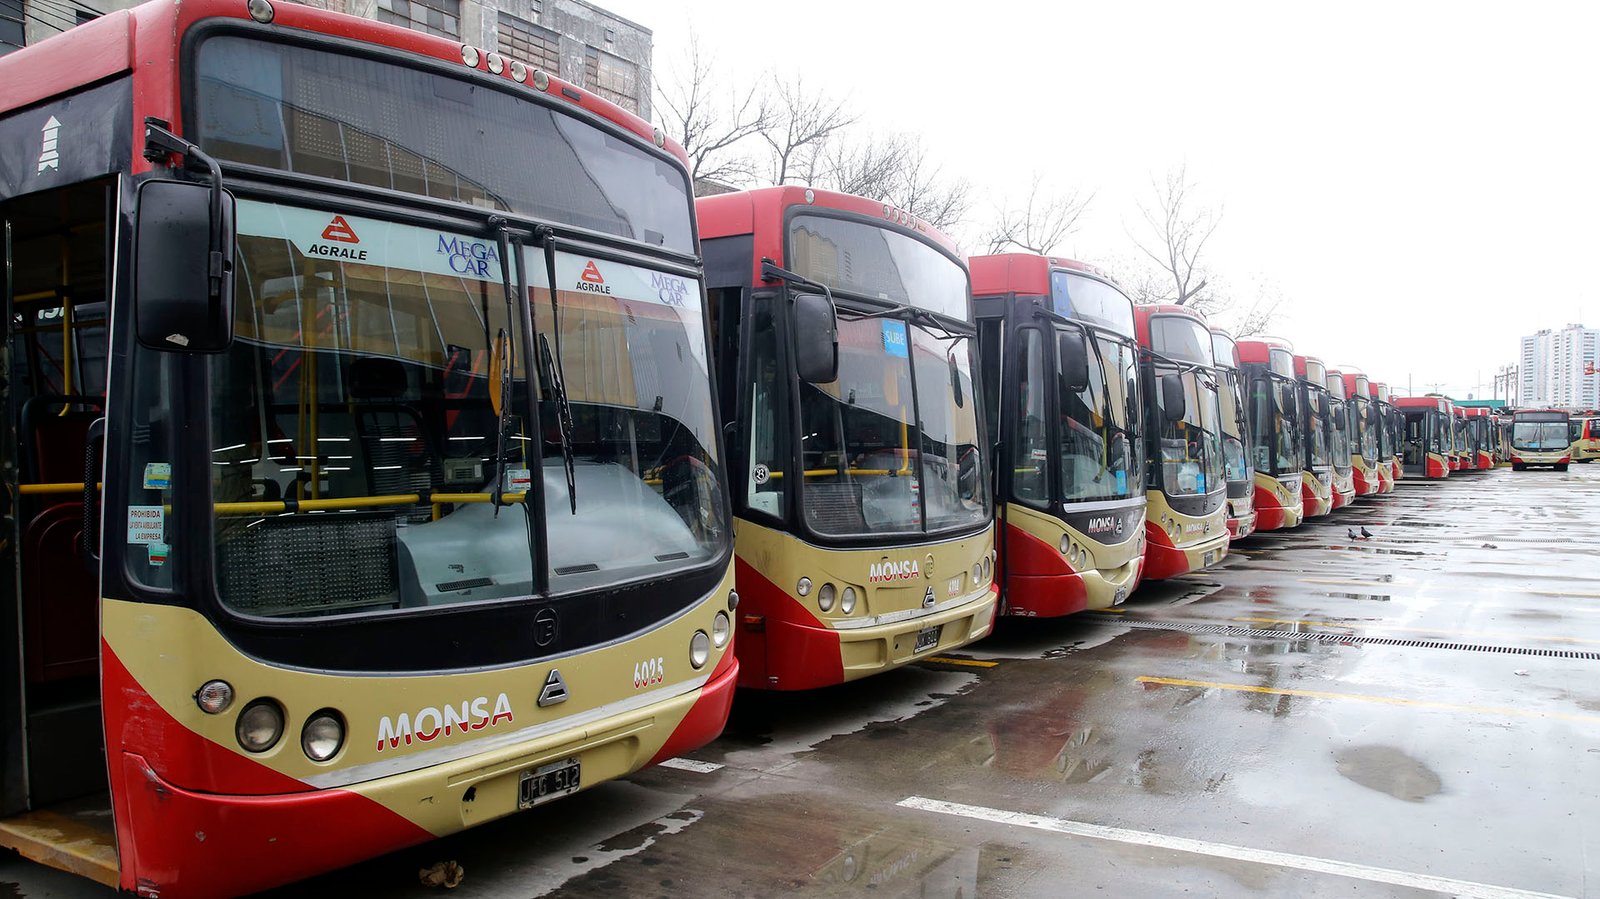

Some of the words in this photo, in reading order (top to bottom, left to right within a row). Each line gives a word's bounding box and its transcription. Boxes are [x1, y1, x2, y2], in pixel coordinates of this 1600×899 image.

[308, 244, 368, 261] AGRALE
[437, 234, 499, 263] MEGA
[449, 254, 492, 279] CAR
[575, 281, 611, 295] AGRALE
[651, 272, 689, 295] MEGA
[658, 289, 685, 307] CAR
[885, 330, 905, 346] SUBE
[130, 510, 161, 518] PROHIBIDA
[1088, 516, 1115, 534] MONSA
[869, 558, 919, 583] MONSA
[633, 656, 664, 689] 6025
[376, 692, 514, 752] MONSA
[555, 765, 579, 790] 512
